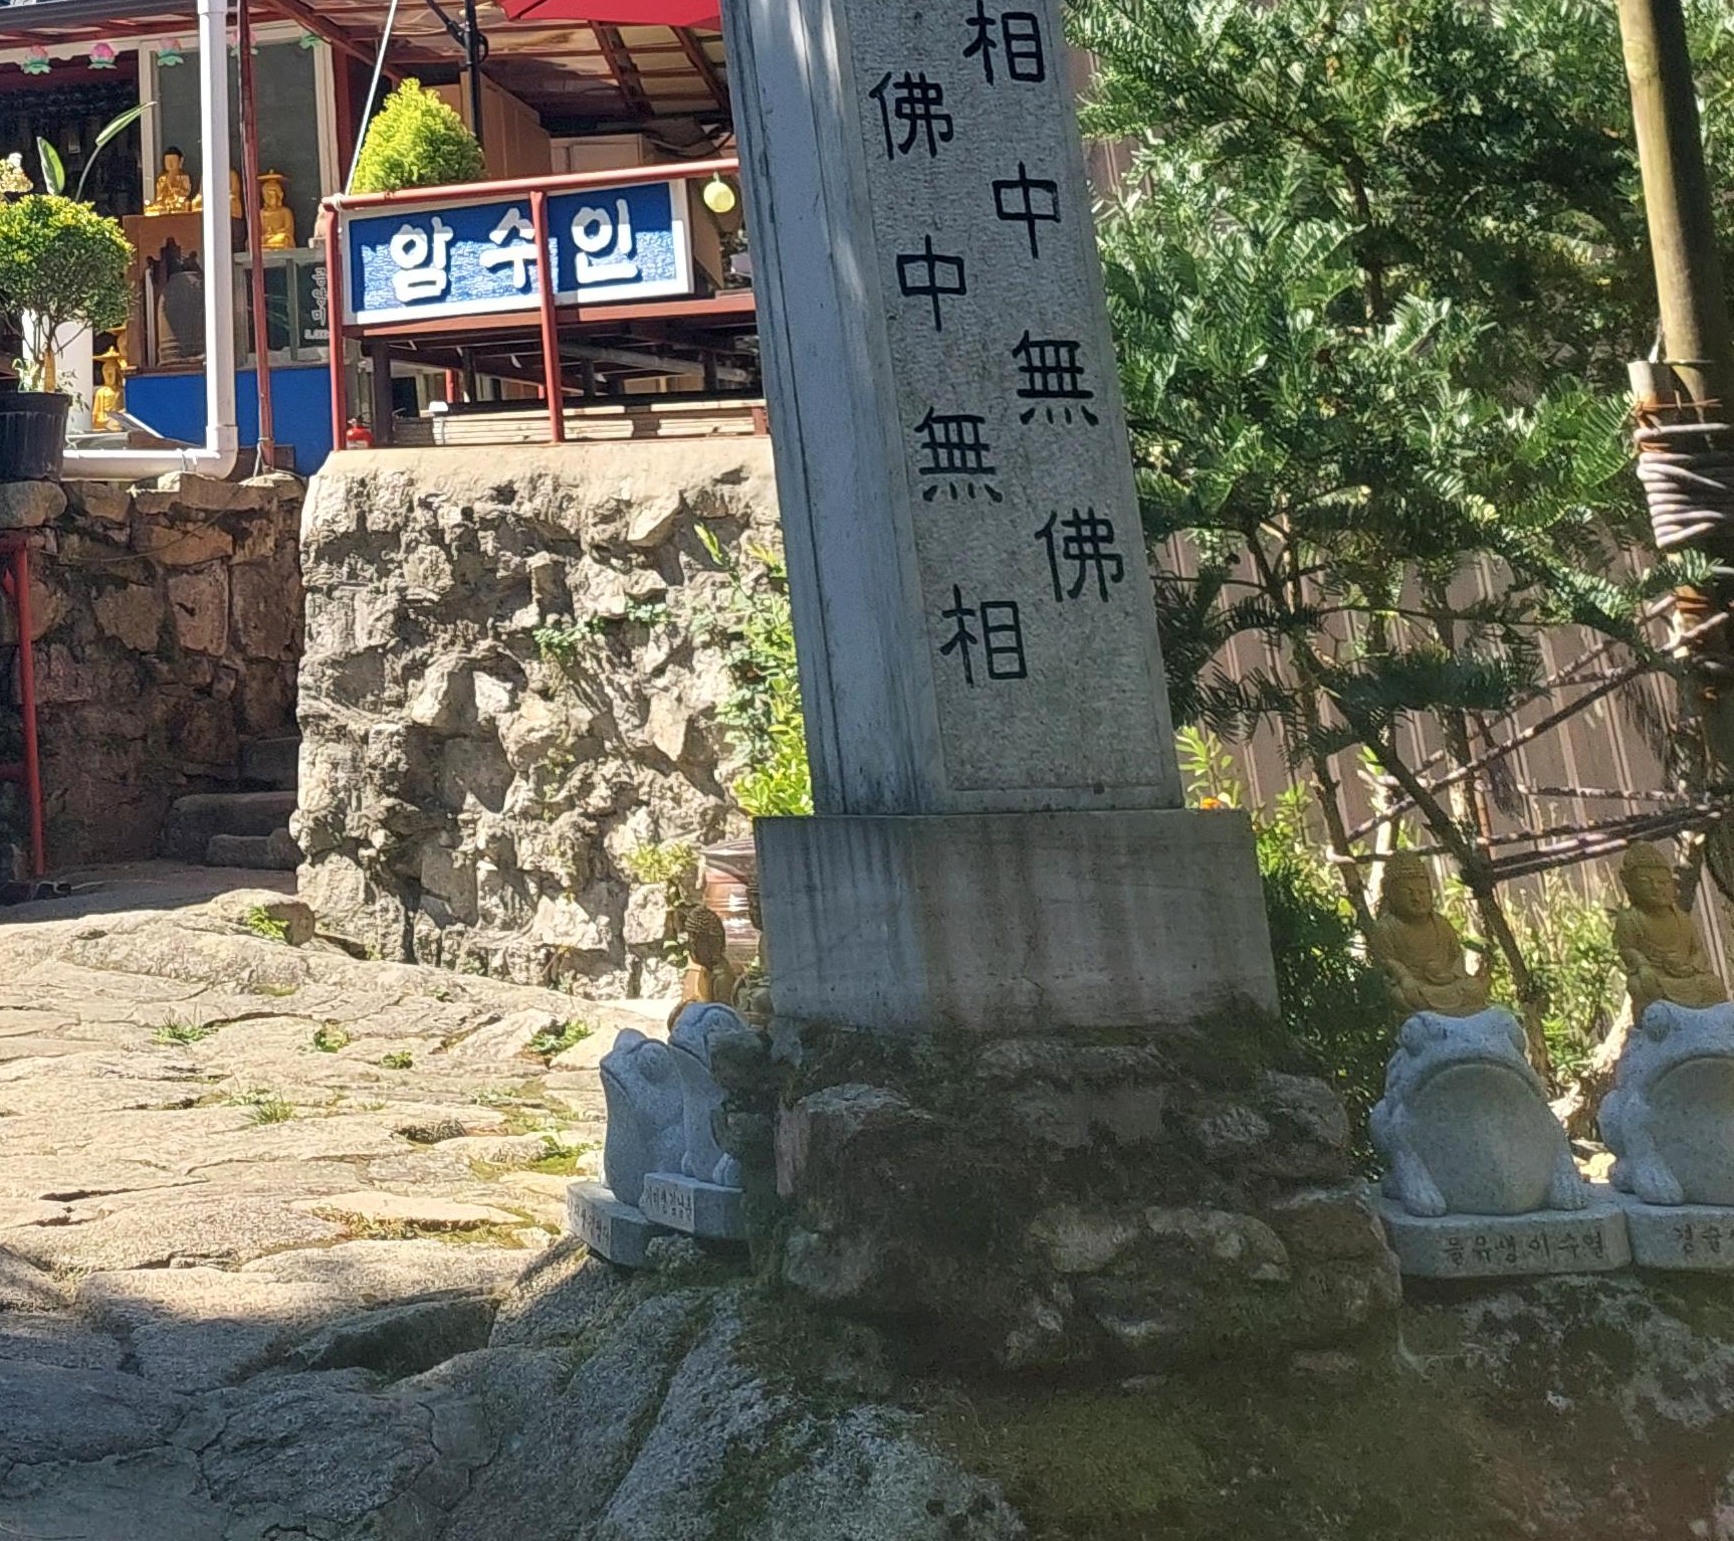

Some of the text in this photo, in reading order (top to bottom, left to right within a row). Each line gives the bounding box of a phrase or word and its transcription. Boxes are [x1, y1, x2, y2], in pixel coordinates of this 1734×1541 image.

[869, 71, 1028, 687] 佛中無相
[962, 0, 1124, 604] 相中無佛
